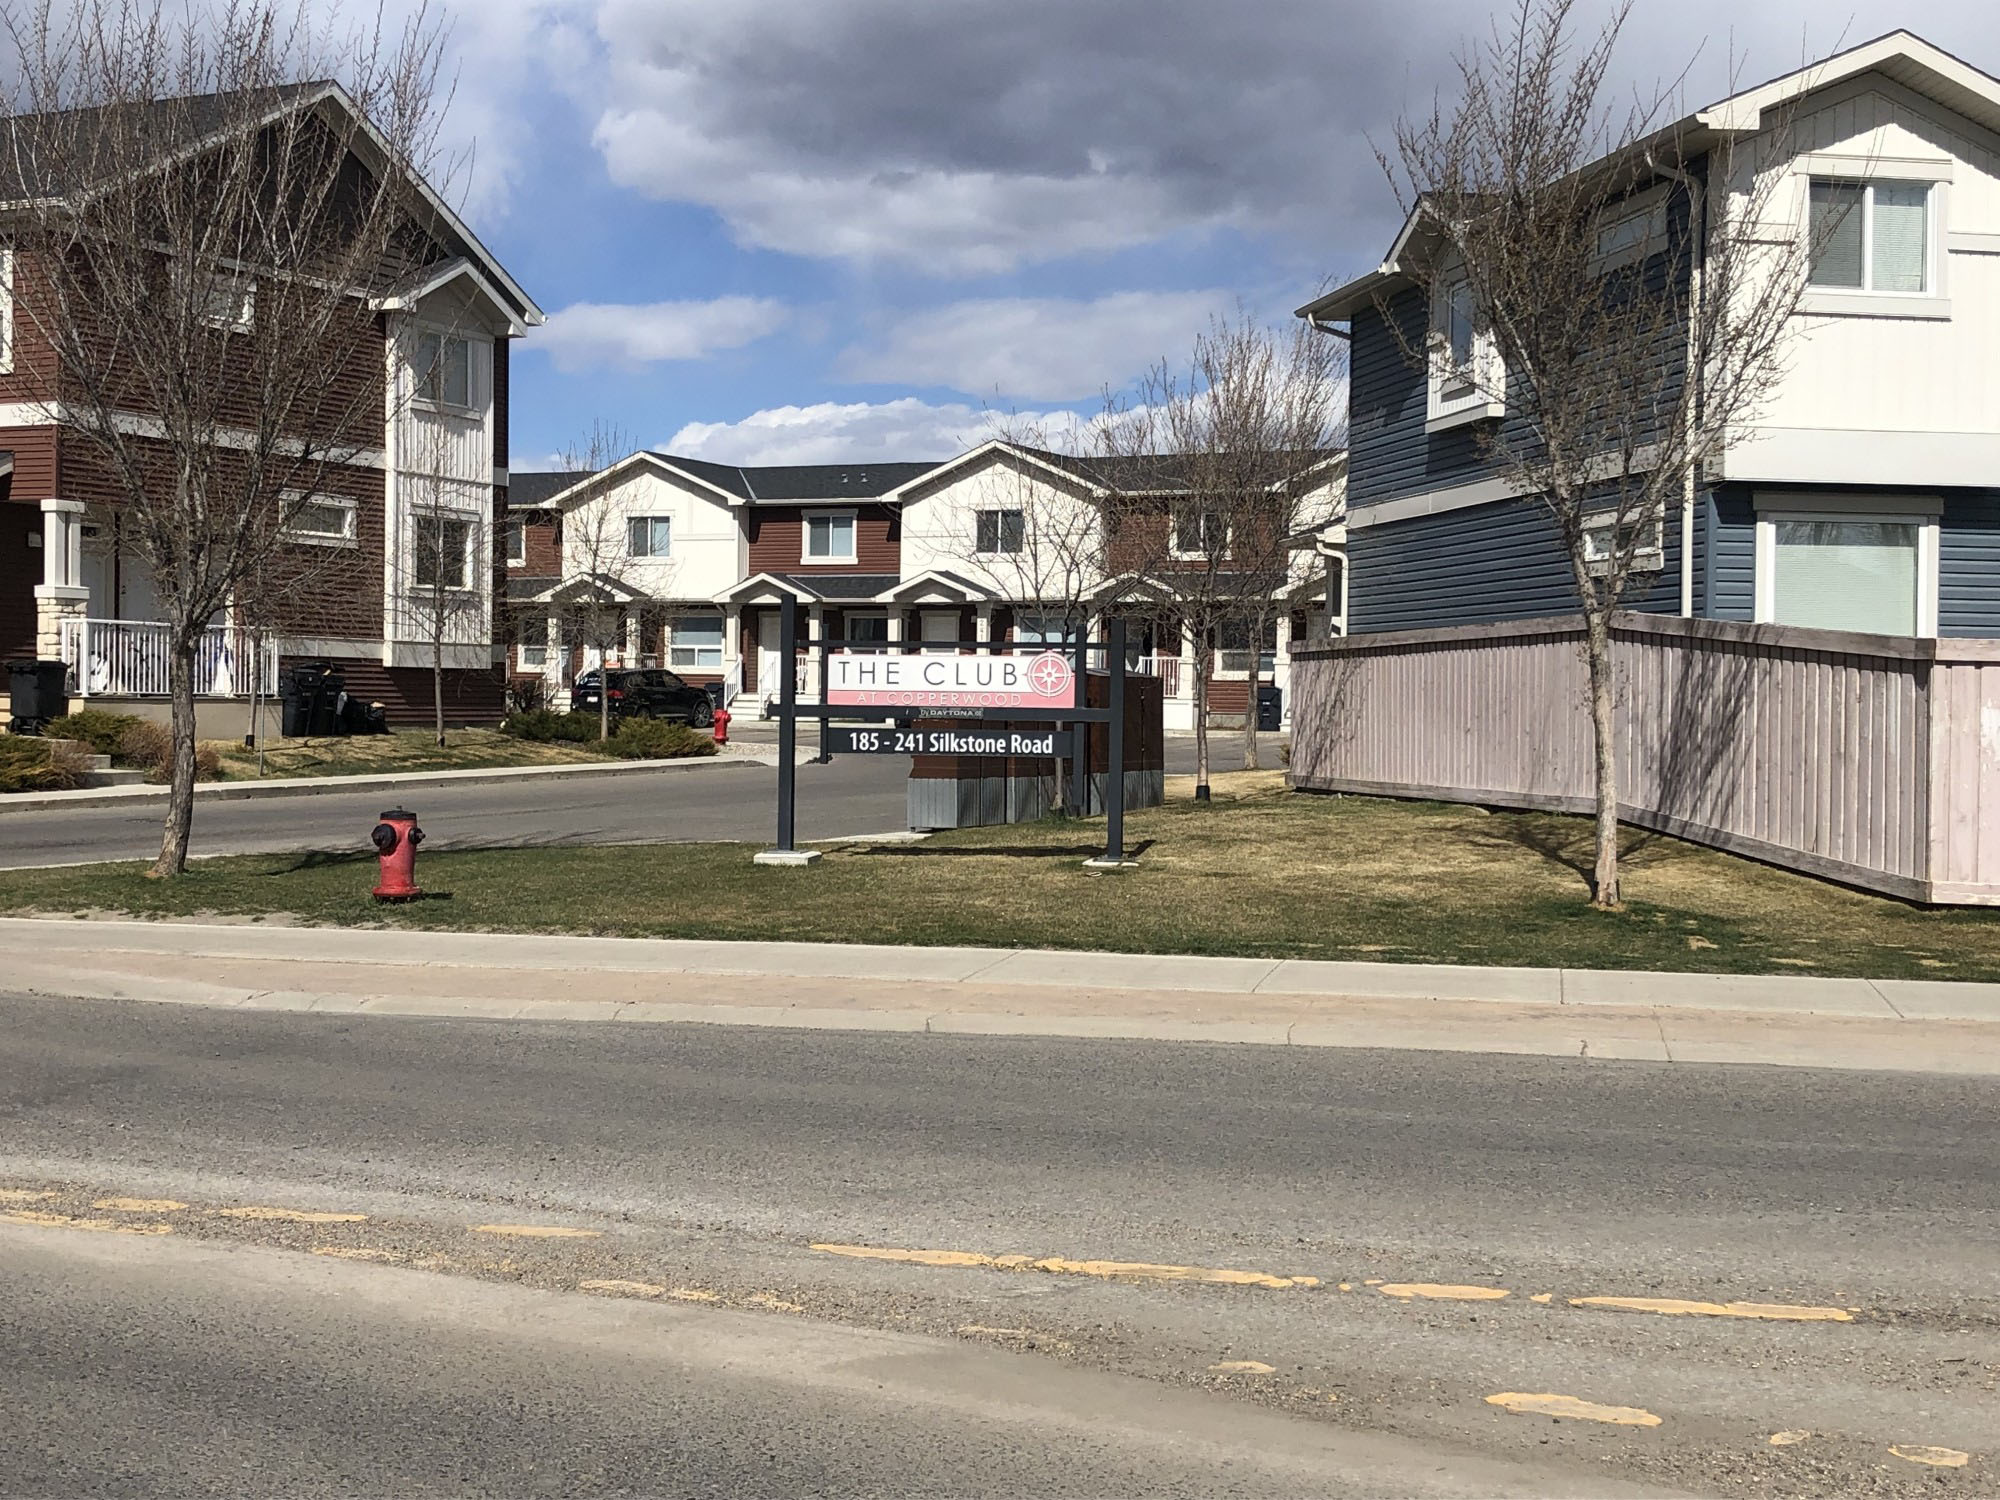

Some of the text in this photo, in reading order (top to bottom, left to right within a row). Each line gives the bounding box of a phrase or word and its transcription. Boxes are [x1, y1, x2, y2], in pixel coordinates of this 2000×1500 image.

[838, 661, 1017, 686] THE CLUB
[857, 692, 1022, 707] AT COPPERWOOD
[920, 709, 929, 717] by
[849, 732, 879, 751] 185
[894, 733, 924, 752] 241
[929, 733, 1006, 753] Silkstone
[1010, 734, 1053, 754] Road
